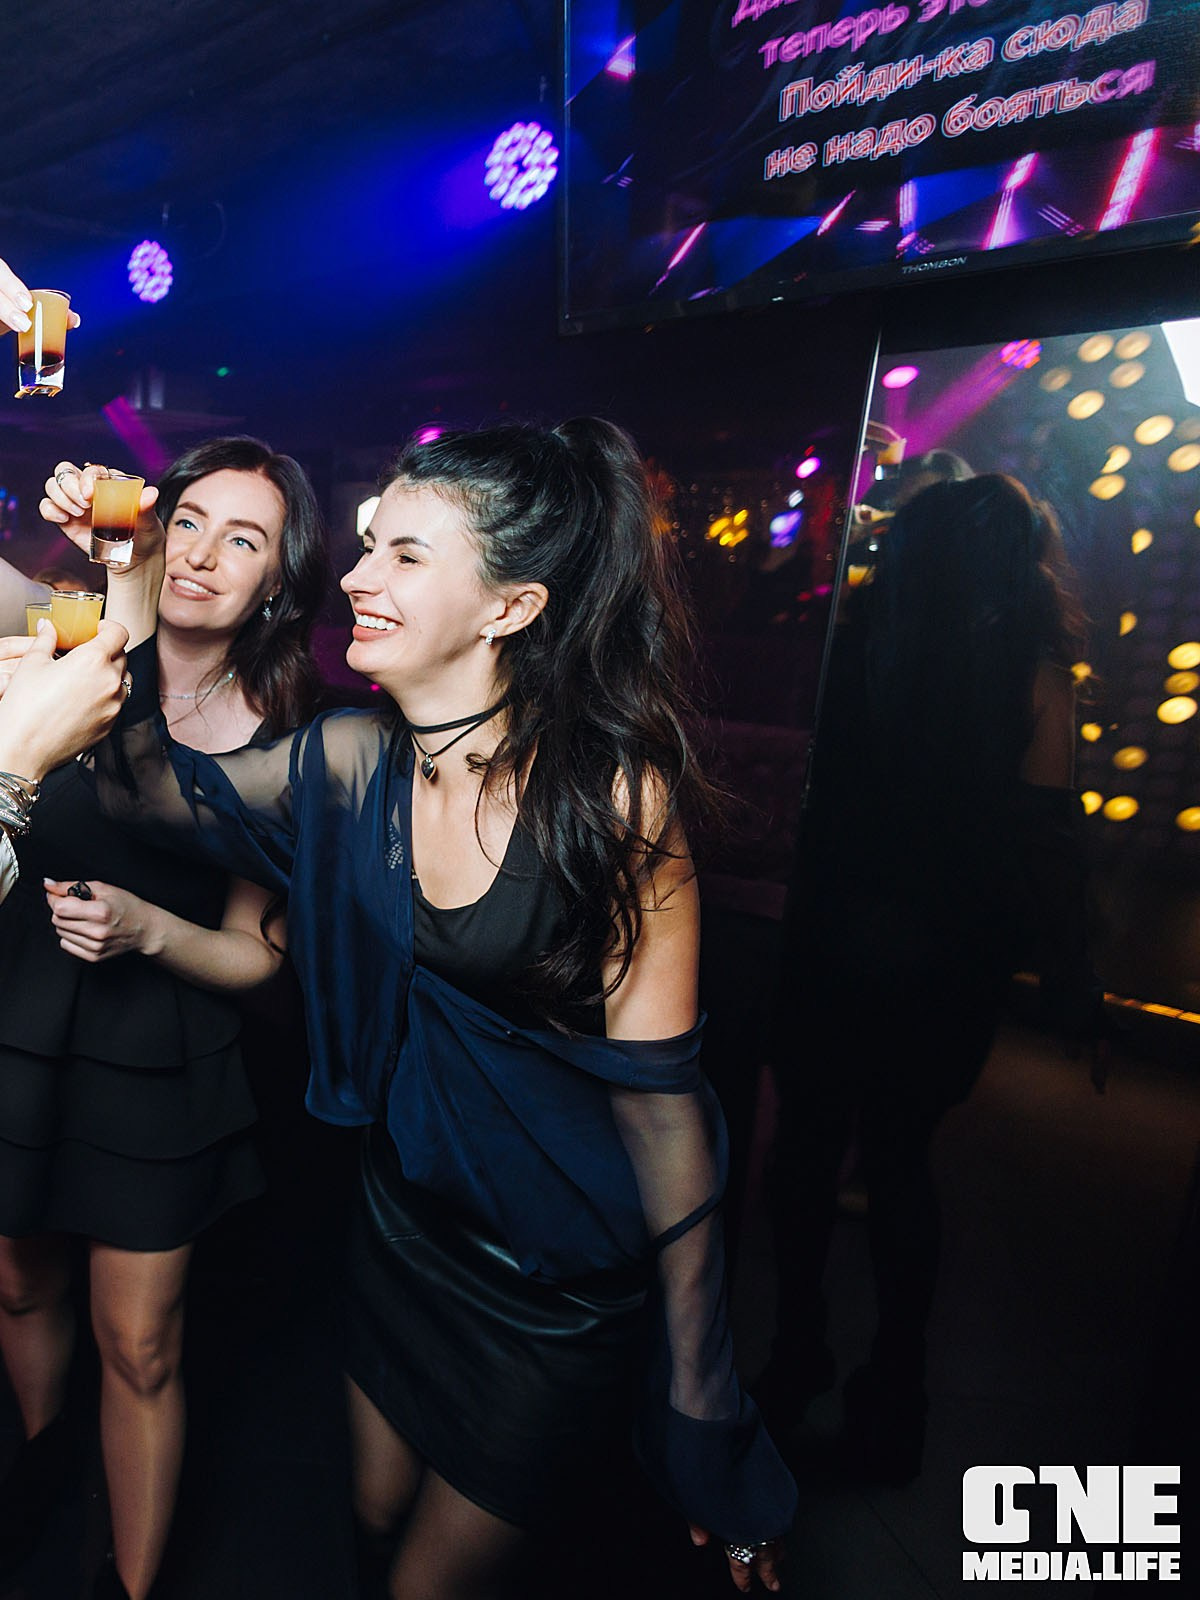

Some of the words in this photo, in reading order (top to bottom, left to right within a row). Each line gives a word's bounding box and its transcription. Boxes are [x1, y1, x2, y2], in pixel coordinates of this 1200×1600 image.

[758, 3, 910, 69] теперь
[779, 37, 995, 122] Пойди-ка
[1001, 0, 1149, 62] сюда
[764, 142, 818, 180] не
[823, 113, 937, 167] надо
[942, 60, 1156, 137] бояться
[902, 256, 968, 274] THOMSON
